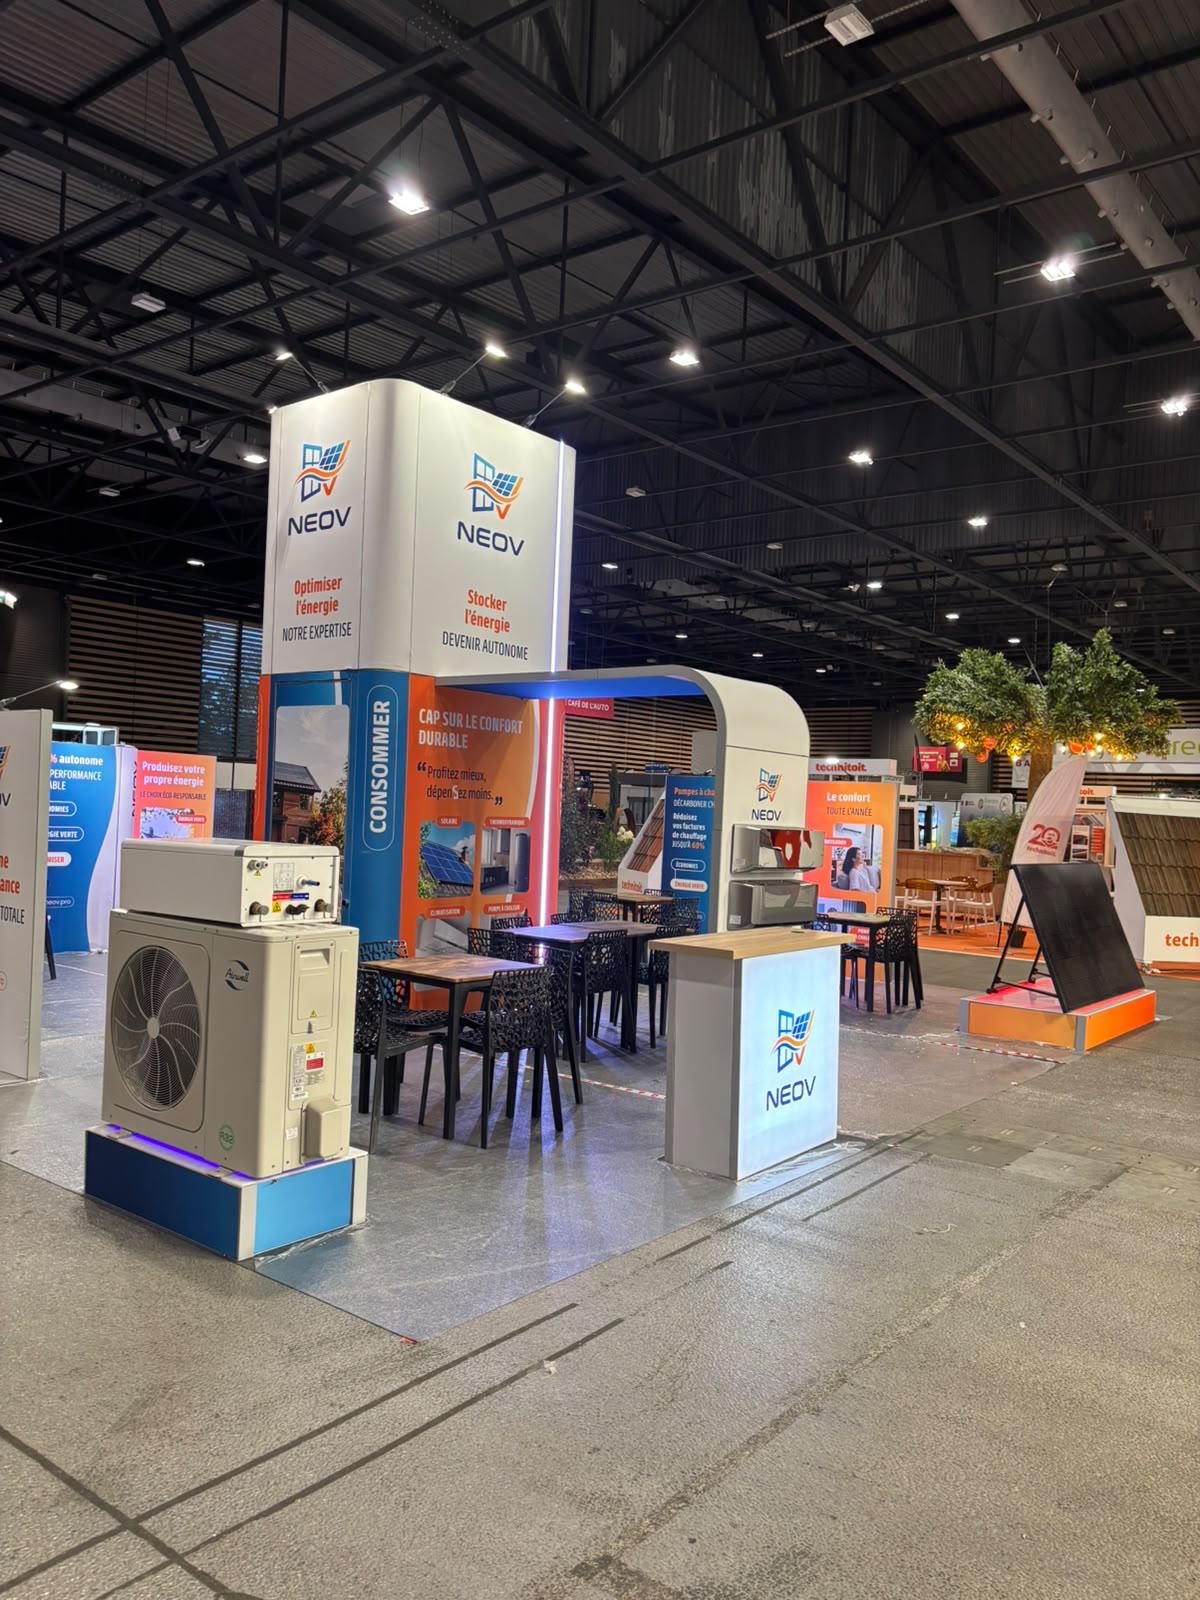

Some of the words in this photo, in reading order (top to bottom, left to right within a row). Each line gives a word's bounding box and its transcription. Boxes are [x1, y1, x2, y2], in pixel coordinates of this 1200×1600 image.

[288, 506, 351, 536] NEOV
[458, 521, 524, 556] NEOV
[295, 576, 342, 597] Optimiser
[296, 596, 339, 616] l'énergie
[467, 589, 507, 612] Stocker
[464, 608, 510, 633] l'énergie
[282, 625, 308, 642] NOTRE
[309, 621, 352, 639] EXPERTISE
[442, 631, 481, 652] DEVENIR
[482, 639, 528, 661] AUTONOME
[419, 708, 440, 725] CAP
[442, 711, 463, 729] SUR
[465, 713, 478, 729] LE
[479, 715, 523, 735] CONFORT
[418, 729, 468, 749] DURABLE
[59, 754, 104, 766] autonome
[142, 761, 183, 774] Produisez
[184, 764, 206, 775] votre
[369, 700, 391, 833] CONSOMMER
[50, 768, 103, 781] PERFORMANCE
[143, 775, 172, 786] propre
[173, 774, 204, 788] énergie
[427, 765, 459, 780] Profitez
[460, 768, 487, 783] mieux,
[468, 786, 494, 800] moins.
[826, 792, 837, 802] Le
[838, 791, 871, 803] confort
[673, 812, 698, 821] Réduisez
[751, 808, 782, 821] NEOV
[826, 806, 846, 816] TOUTE
[847, 805, 873, 817] L'ANNÉE
[672, 831, 679, 839] de
[682, 821, 705, 831] factures
[0, 905, 24, 924] TOTALE
[766, 1075, 817, 1111] NEOV
